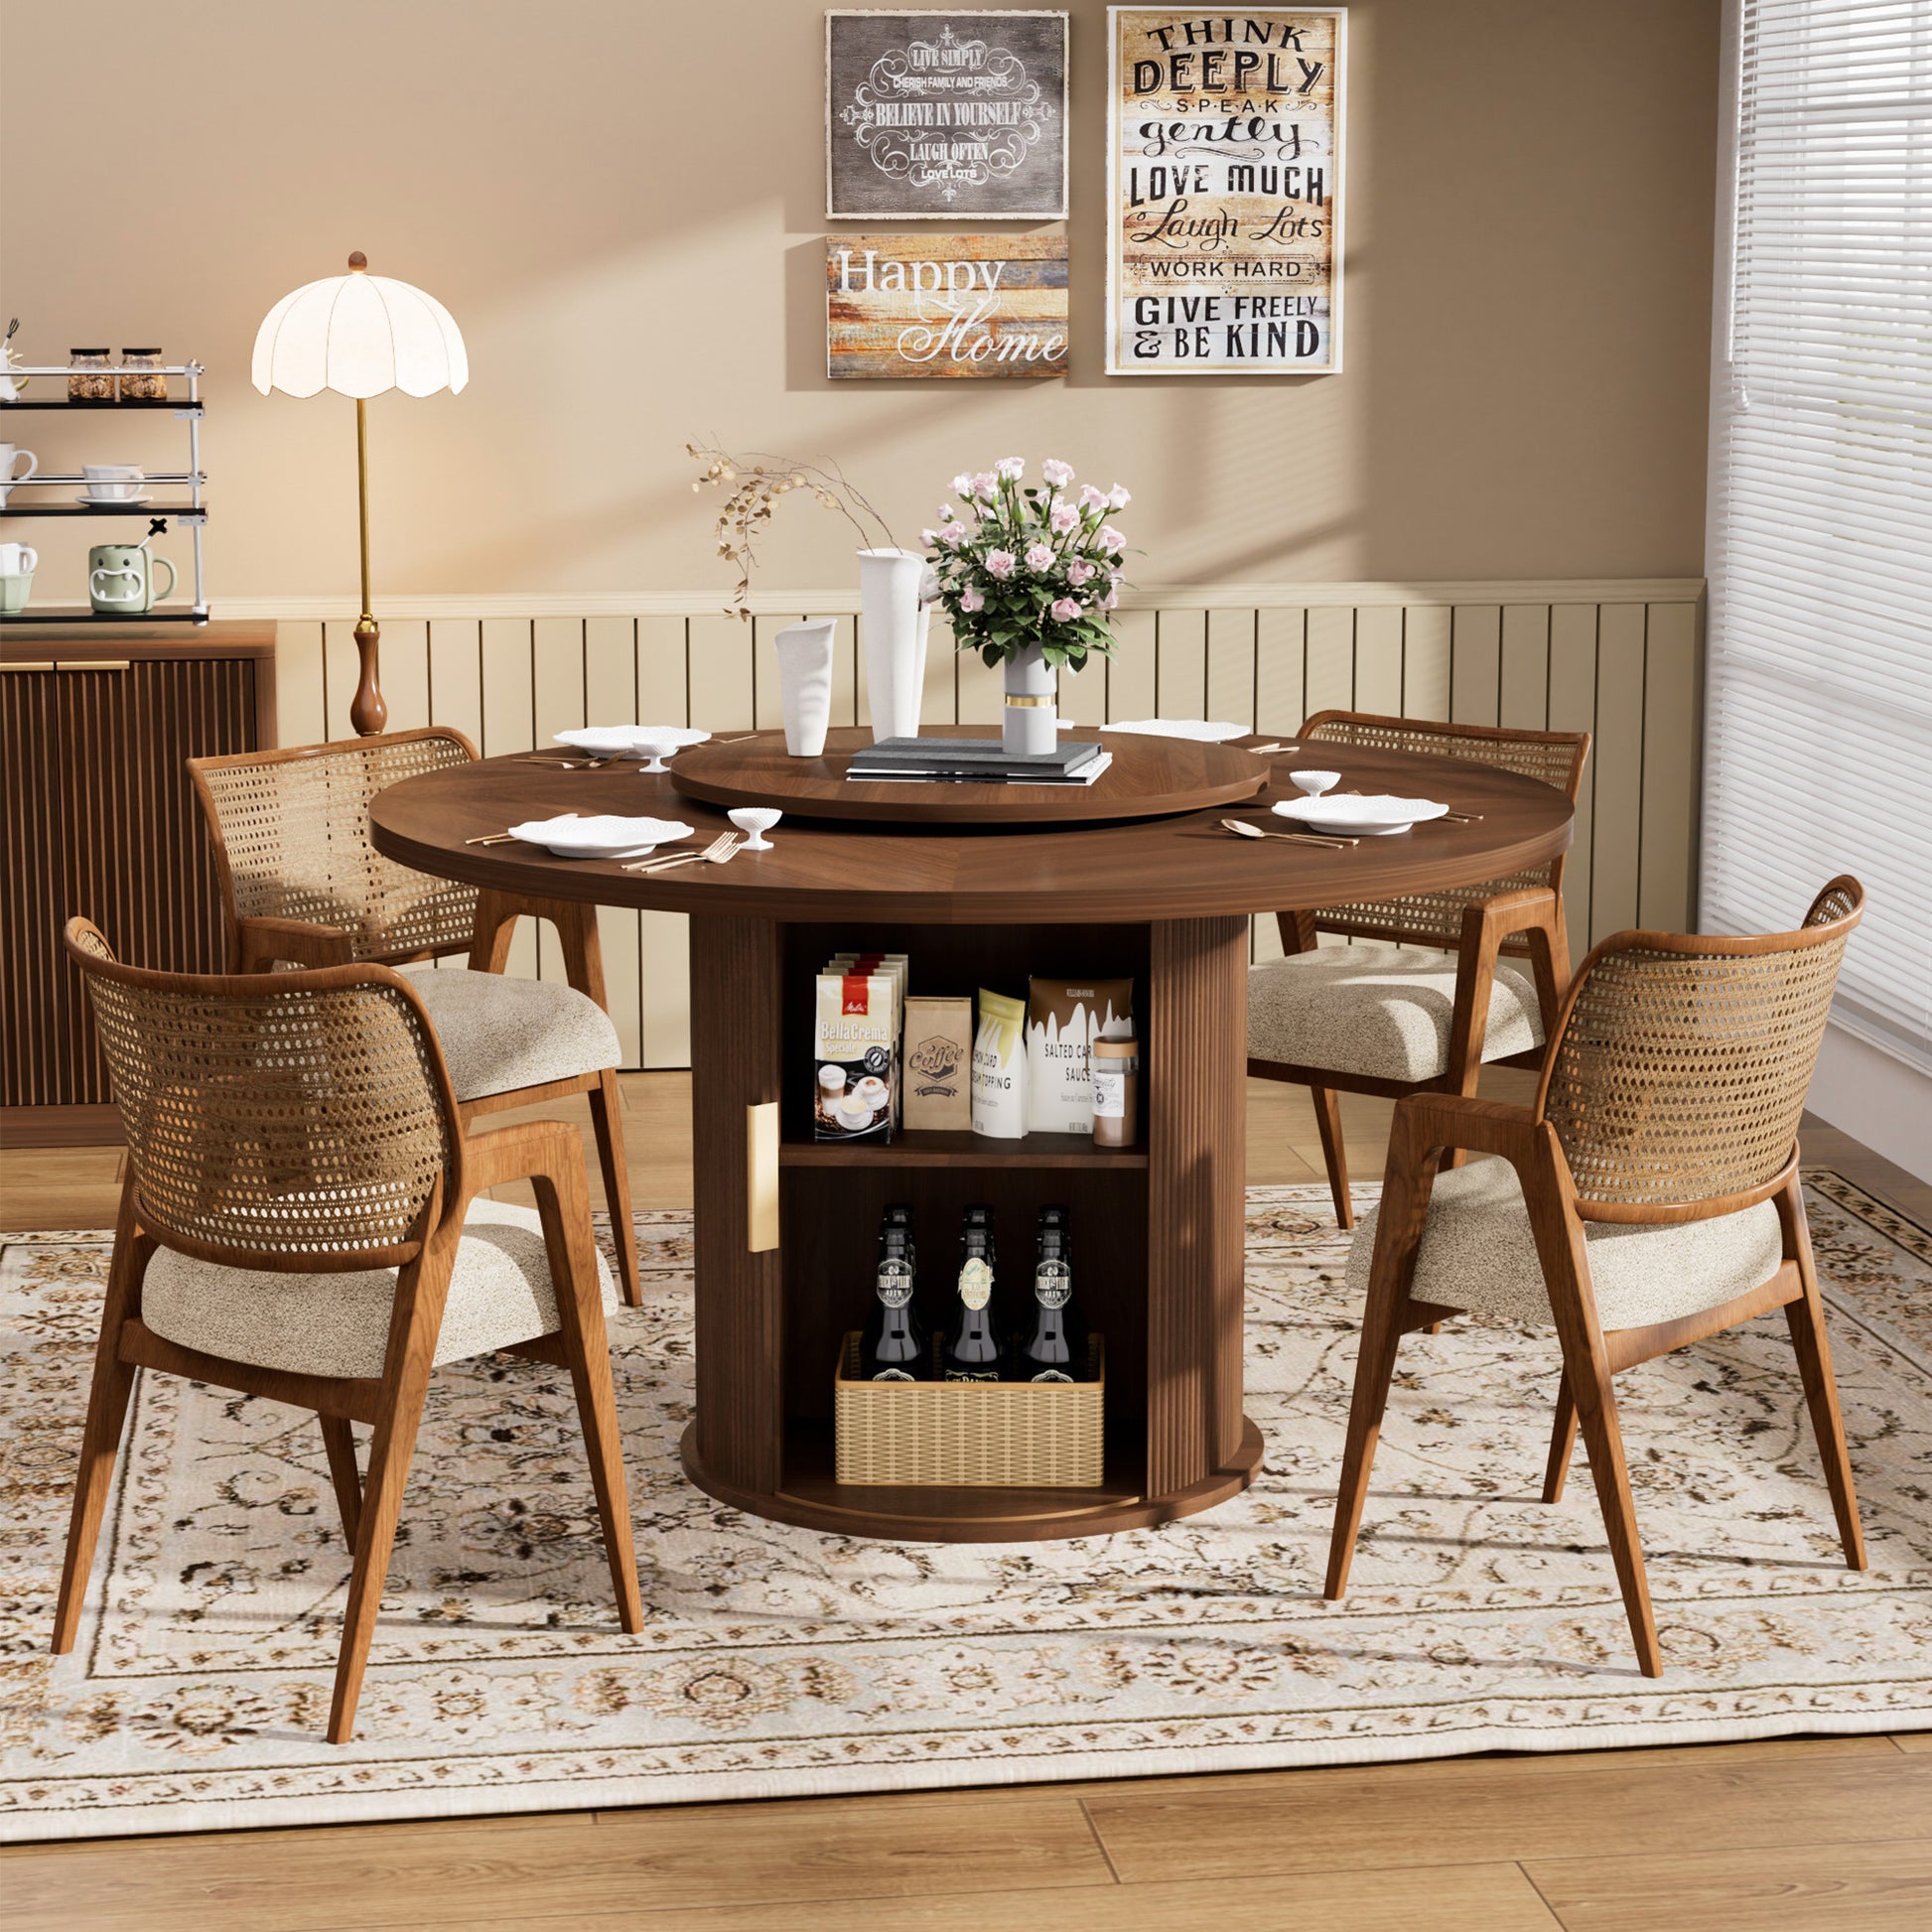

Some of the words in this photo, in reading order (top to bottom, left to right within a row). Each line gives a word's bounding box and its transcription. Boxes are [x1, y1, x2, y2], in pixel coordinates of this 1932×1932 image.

[1146, 19, 1311, 52] THINK
[912, 50, 938, 67] LIVE
[941, 49, 984, 67] SIMPLY
[894, 76, 927, 88] CHERISH
[928, 76, 955, 88] FAMILY
[956, 76, 974, 88] AND
[975, 76, 1008, 88] FRIENDS
[1134, 51, 1326, 95] DEEPLY
[876, 103, 933, 126] BELIEVE
[936, 103, 951, 126] IN
[953, 101, 1022, 125] YOURSELF
[1139, 115, 1319, 161] gently
[909, 143, 948, 160] LAUGH
[951, 142, 989, 160] OFTEN
[921, 170, 948, 179] LOVE
[950, 169, 977, 179] LOTS
[1131, 165, 1208, 207] LOVE
[1228, 165, 1323, 207] MUCH
[1126, 199, 1238, 251] Laugh
[1243, 206, 1323, 245] Lots
[836, 250, 1007, 307] Happy
[1151, 261, 1224, 277] WORK
[1234, 261, 1302, 277] HARD
[1135, 296, 1220, 326] GIVE
[1235, 296, 1318, 320] FREELY
[897, 295, 1069, 363] Home
[1134, 330, 1162, 358] &
[1174, 326, 1210, 358] BE
[1226, 320, 1320, 358] KIND
[821, 1021, 889, 1041] BellaCrema
[909, 1046, 964, 1069] Coffee
[1045, 1043, 1073, 1058] SALTED
[1066, 1067, 1091, 1082] SAUCE
